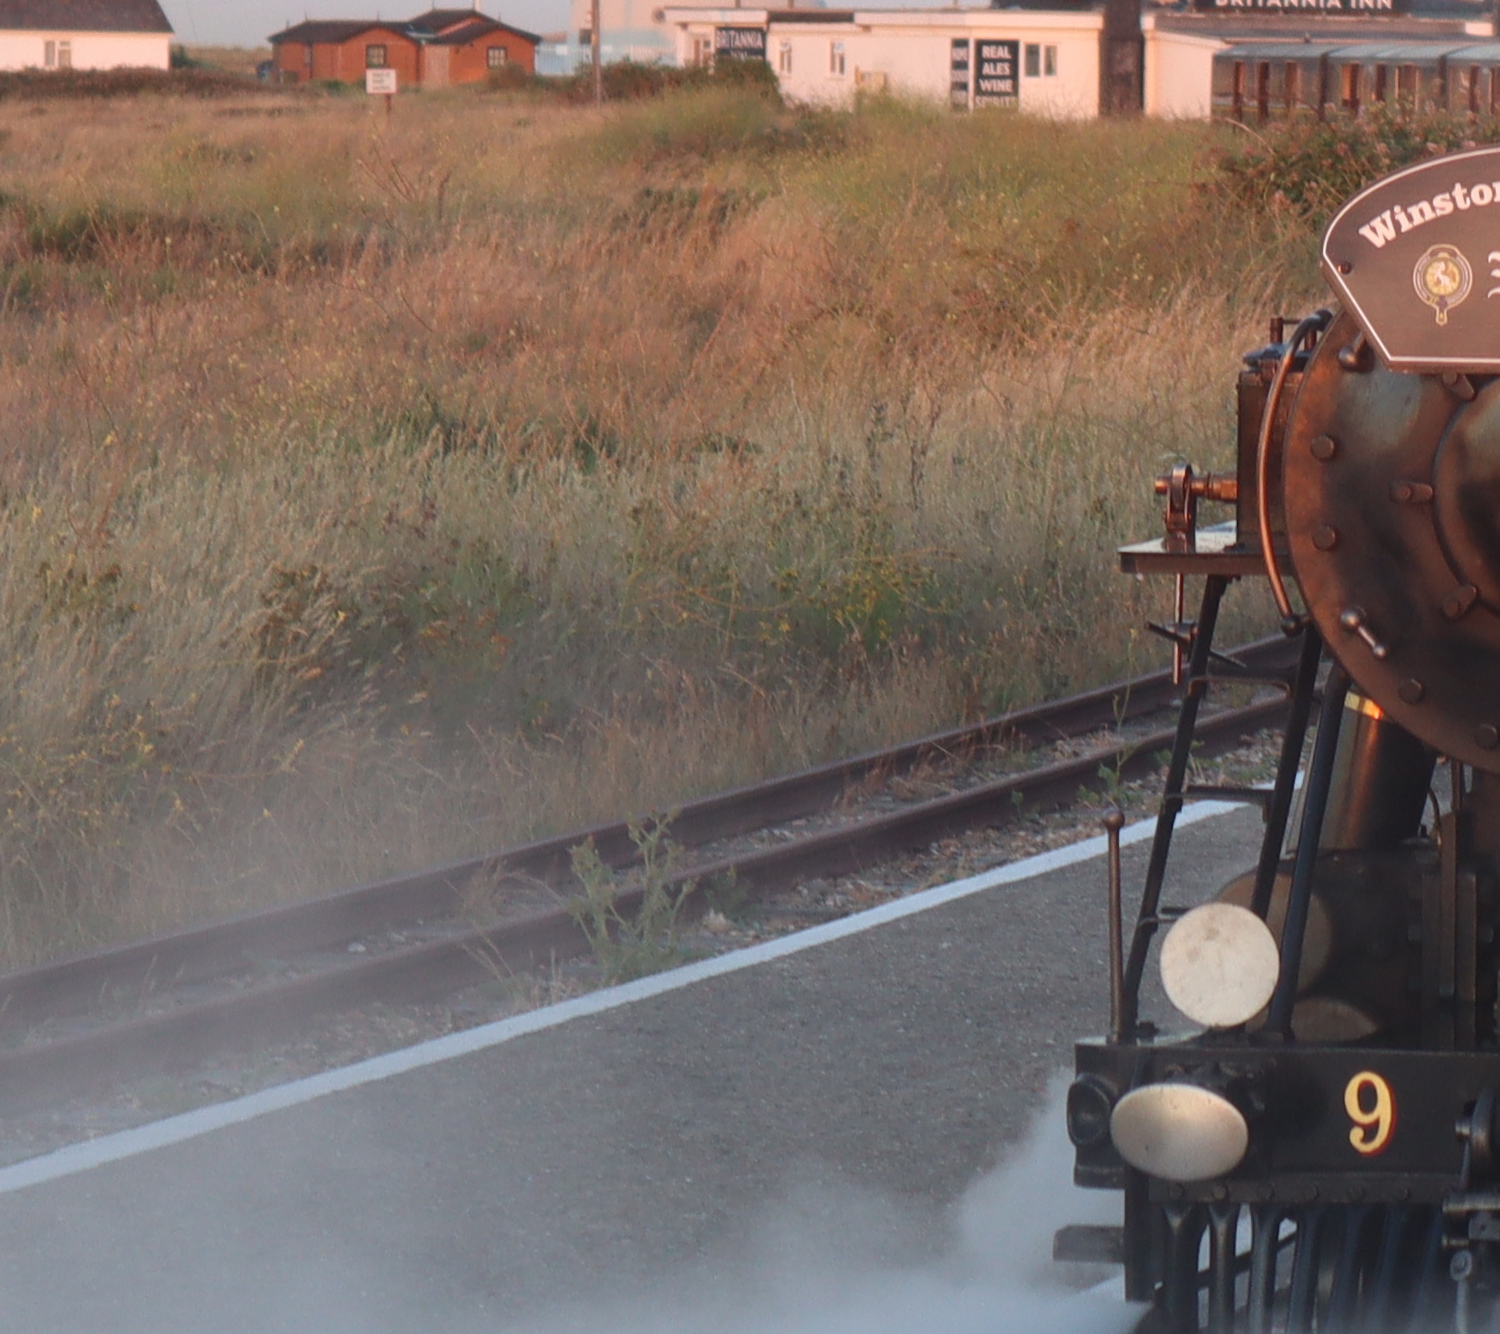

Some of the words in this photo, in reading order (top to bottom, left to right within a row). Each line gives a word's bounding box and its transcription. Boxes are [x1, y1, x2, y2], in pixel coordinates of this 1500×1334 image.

[982, 45, 1012, 60] REAL
[982, 62, 1011, 76] ALES
[979, 78, 1014, 93] WINE
[1343, 1070, 1396, 1156] 9
